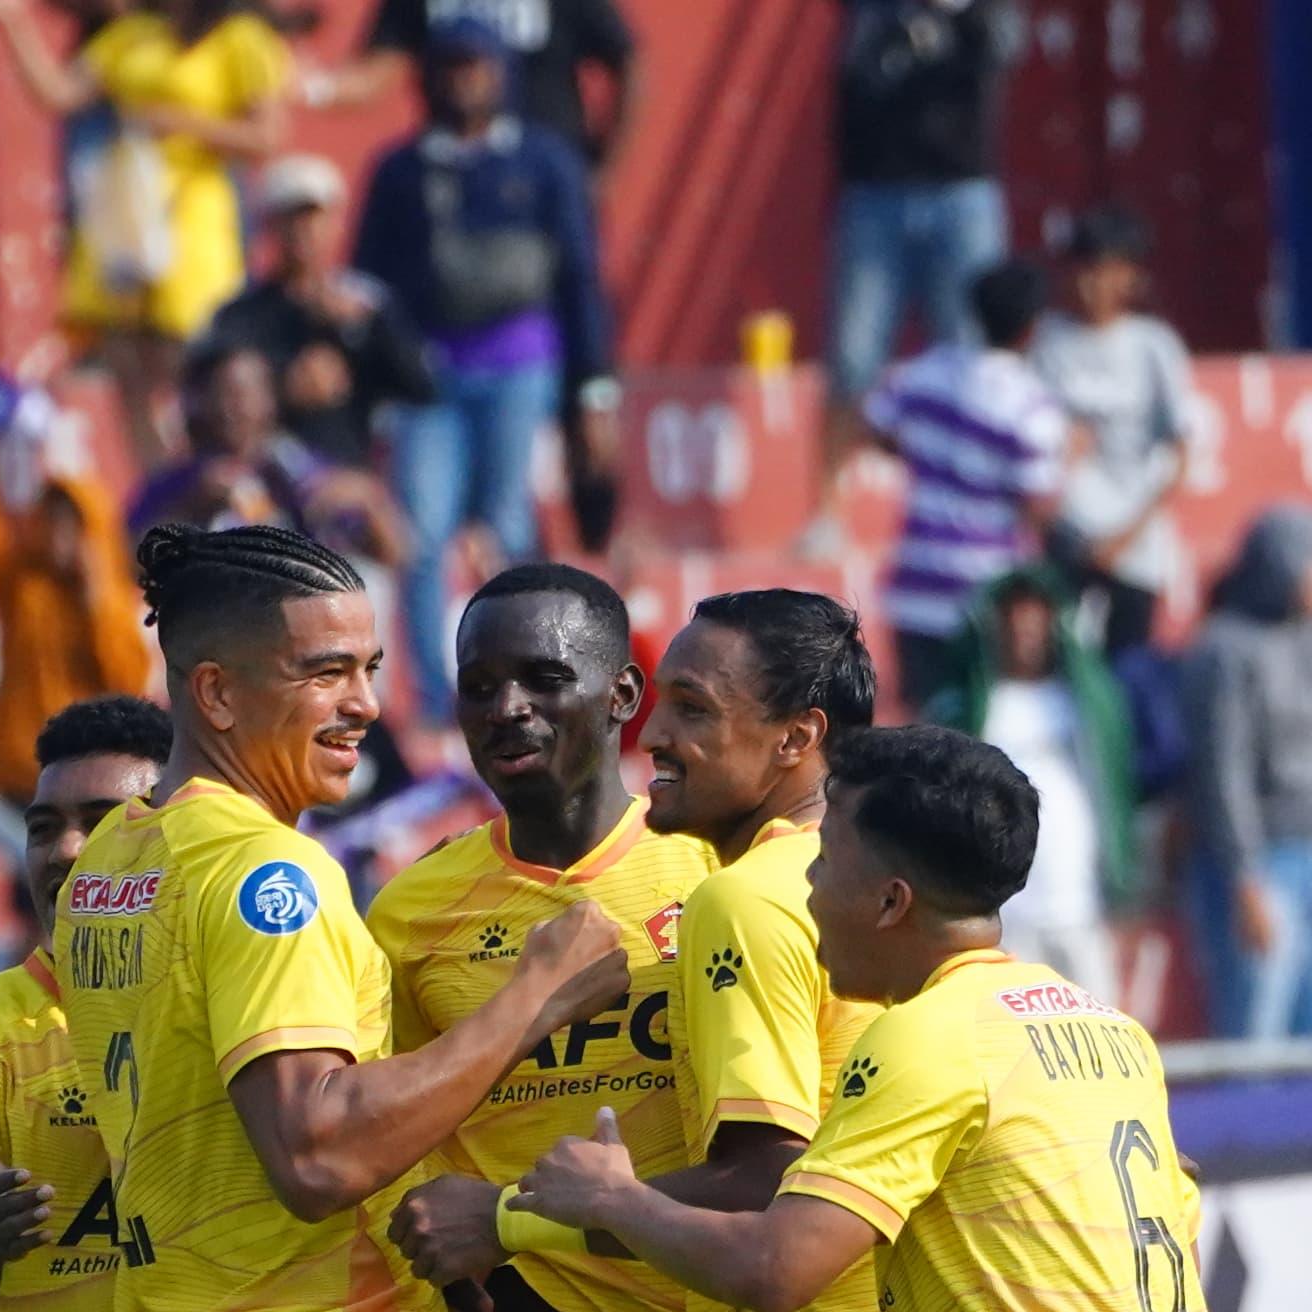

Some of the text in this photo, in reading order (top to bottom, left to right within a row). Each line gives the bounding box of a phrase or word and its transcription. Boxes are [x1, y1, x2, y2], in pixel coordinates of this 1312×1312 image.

[468, 948, 520, 963] KELME
[1000, 984, 1081, 1014] EXTRA
[1024, 1021, 1104, 1080] BAYU
